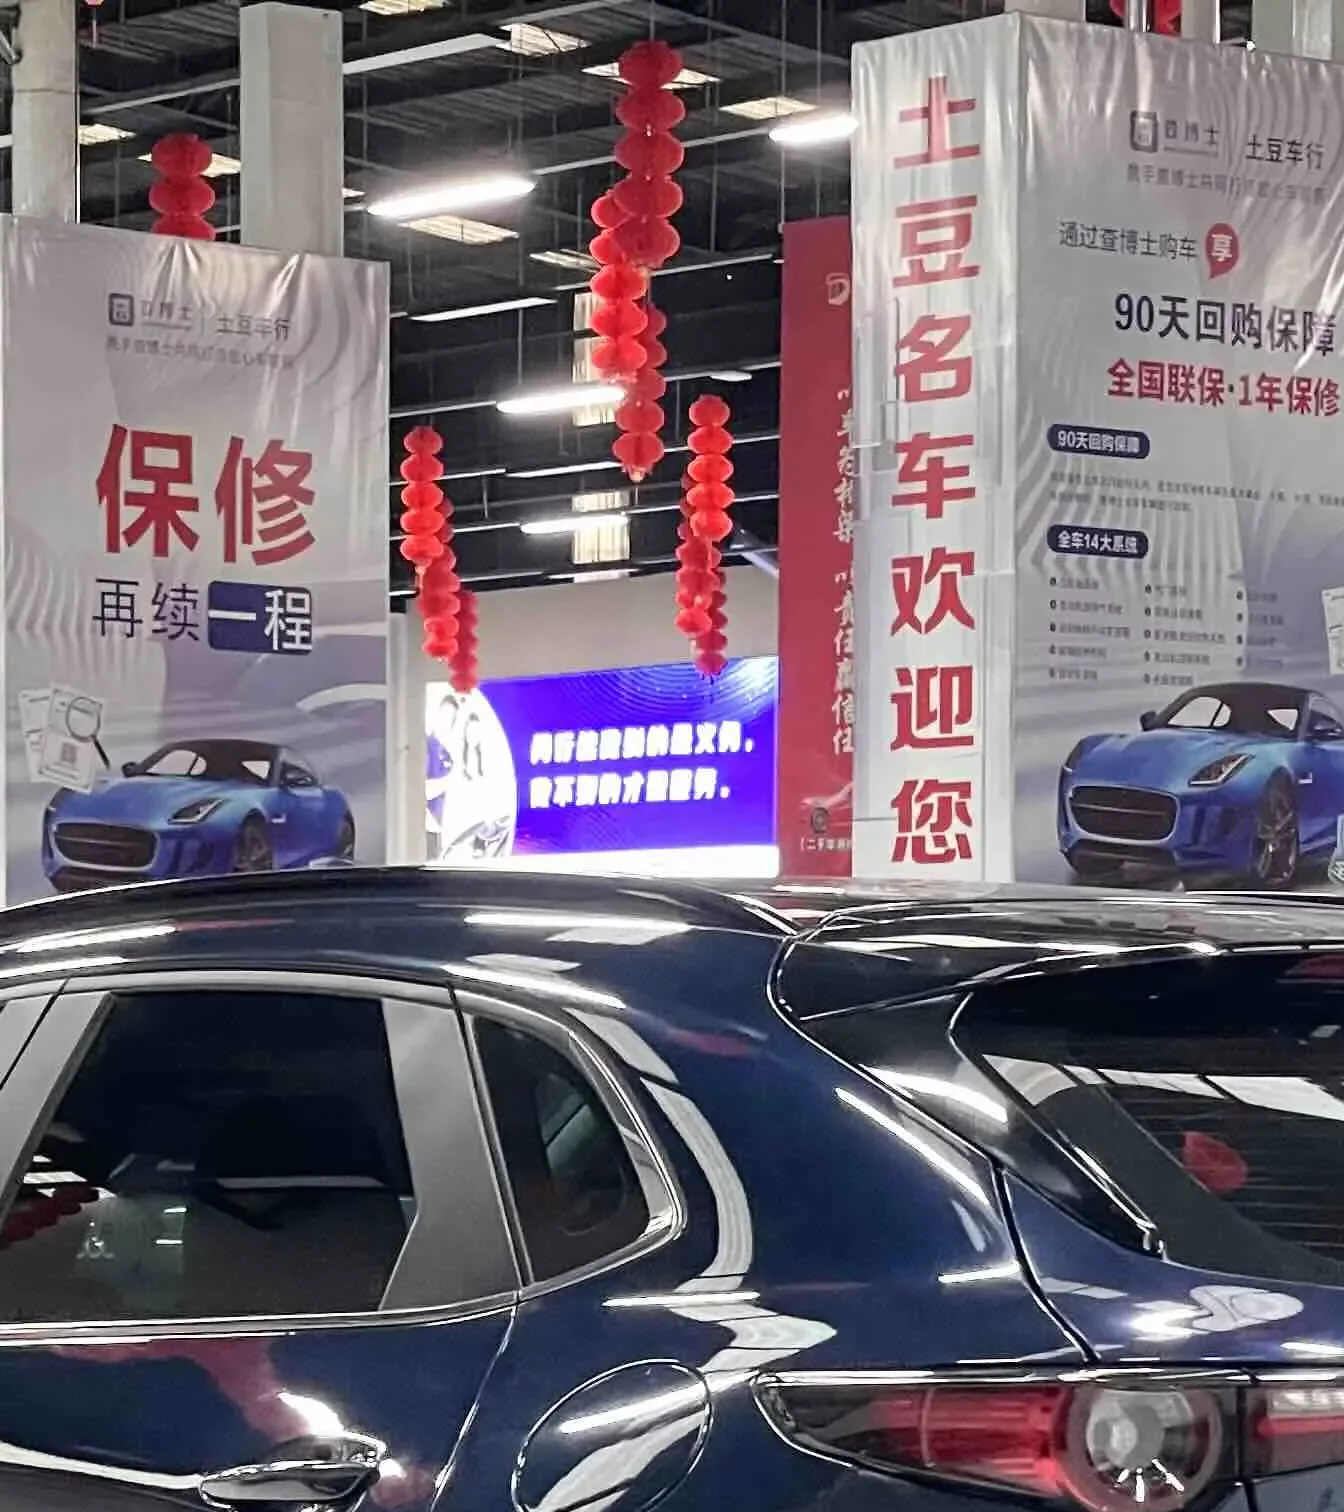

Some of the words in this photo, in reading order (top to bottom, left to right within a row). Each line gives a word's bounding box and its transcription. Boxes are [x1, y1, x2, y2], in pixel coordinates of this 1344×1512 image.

[1245, 134, 1324, 170] 土豆车行
[1058, 221, 1198, 261] 通过查博士购车
[1114, 293, 1337, 356] 90天回购保障
[96, 423, 316, 568] 保修
[890, 76, 981, 866] 土豆名车欢迎您
[92, 577, 313, 652] 再续一程
